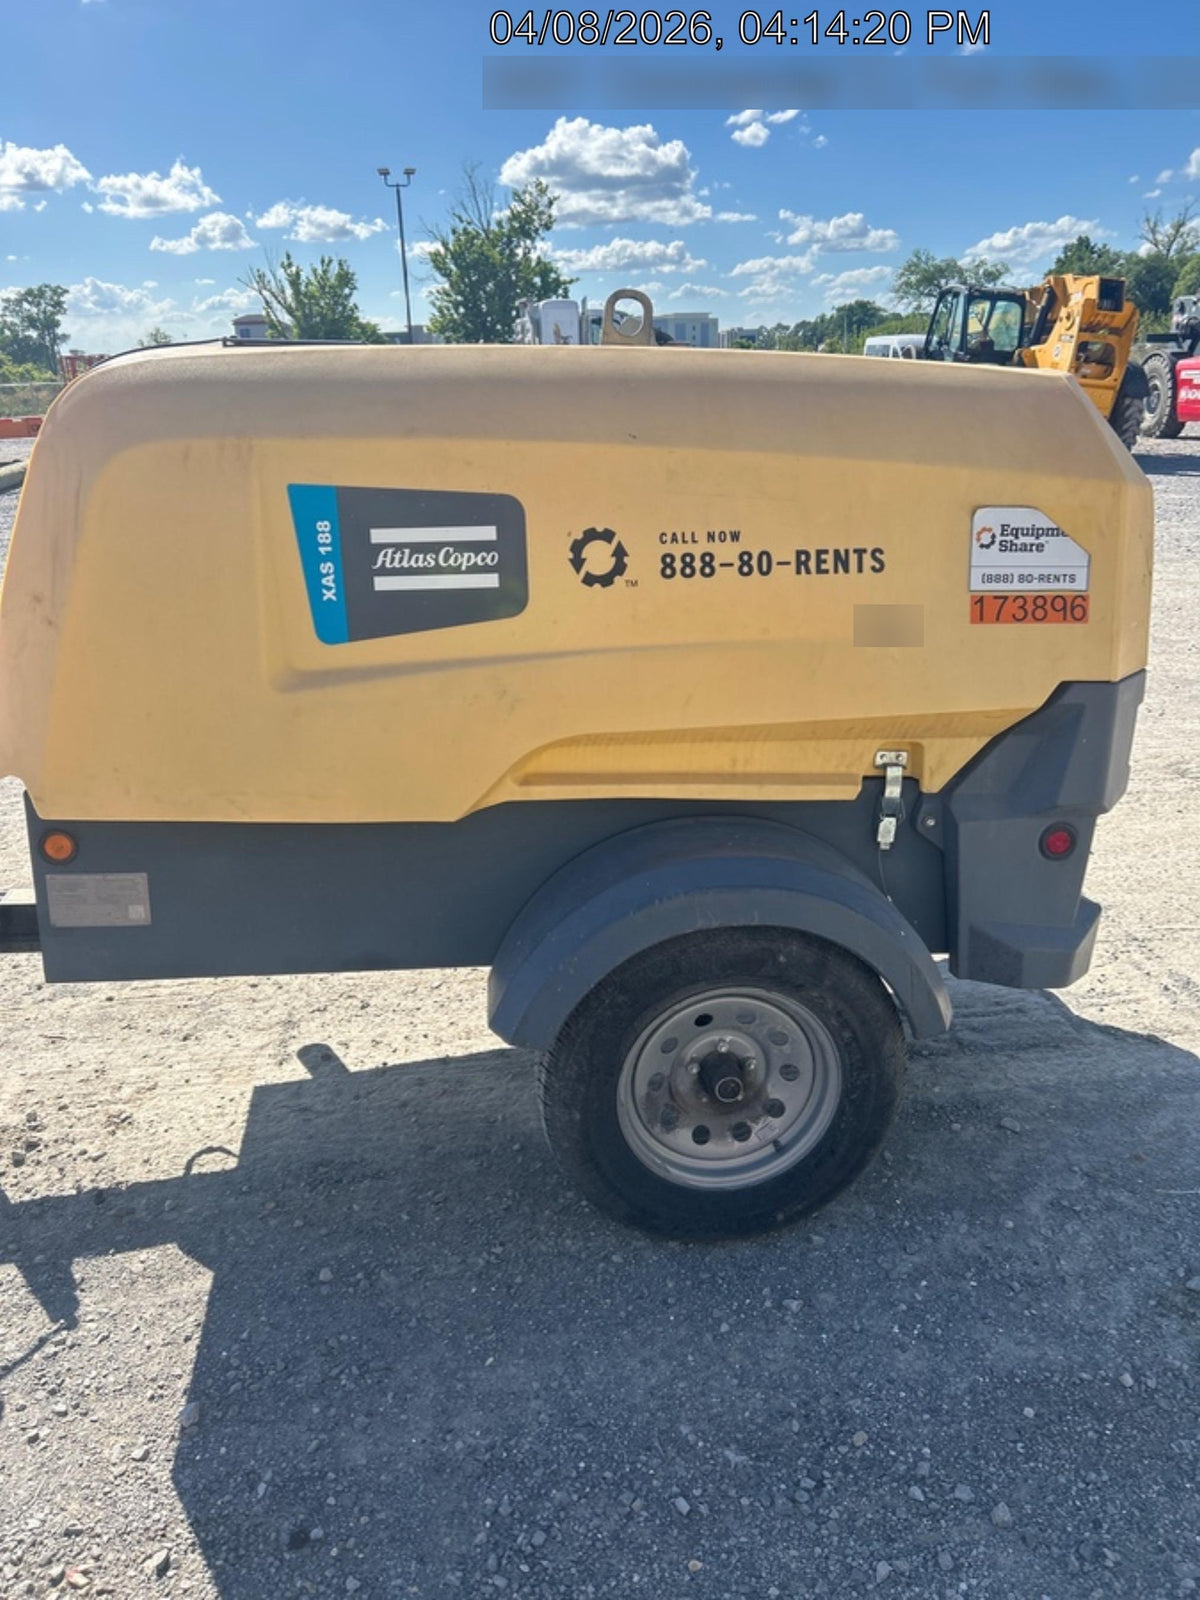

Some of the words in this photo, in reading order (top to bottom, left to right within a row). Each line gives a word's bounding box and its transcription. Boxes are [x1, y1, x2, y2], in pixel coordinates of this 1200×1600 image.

[316, 520, 332, 555] 188
[659, 532, 699, 545] CALL
[707, 530, 741, 543] NOW
[998, 540, 1045, 553] Share
[372, 548, 435, 569] Atlas
[438, 547, 498, 570] Copco
[660, 547, 886, 579] 888-80-RENTS
[320, 562, 337, 601] XAS
[981, 573, 1015, 584] (888)
[1018, 573, 1077, 584] 80-RENTS
[973, 595, 1087, 622] 173896
